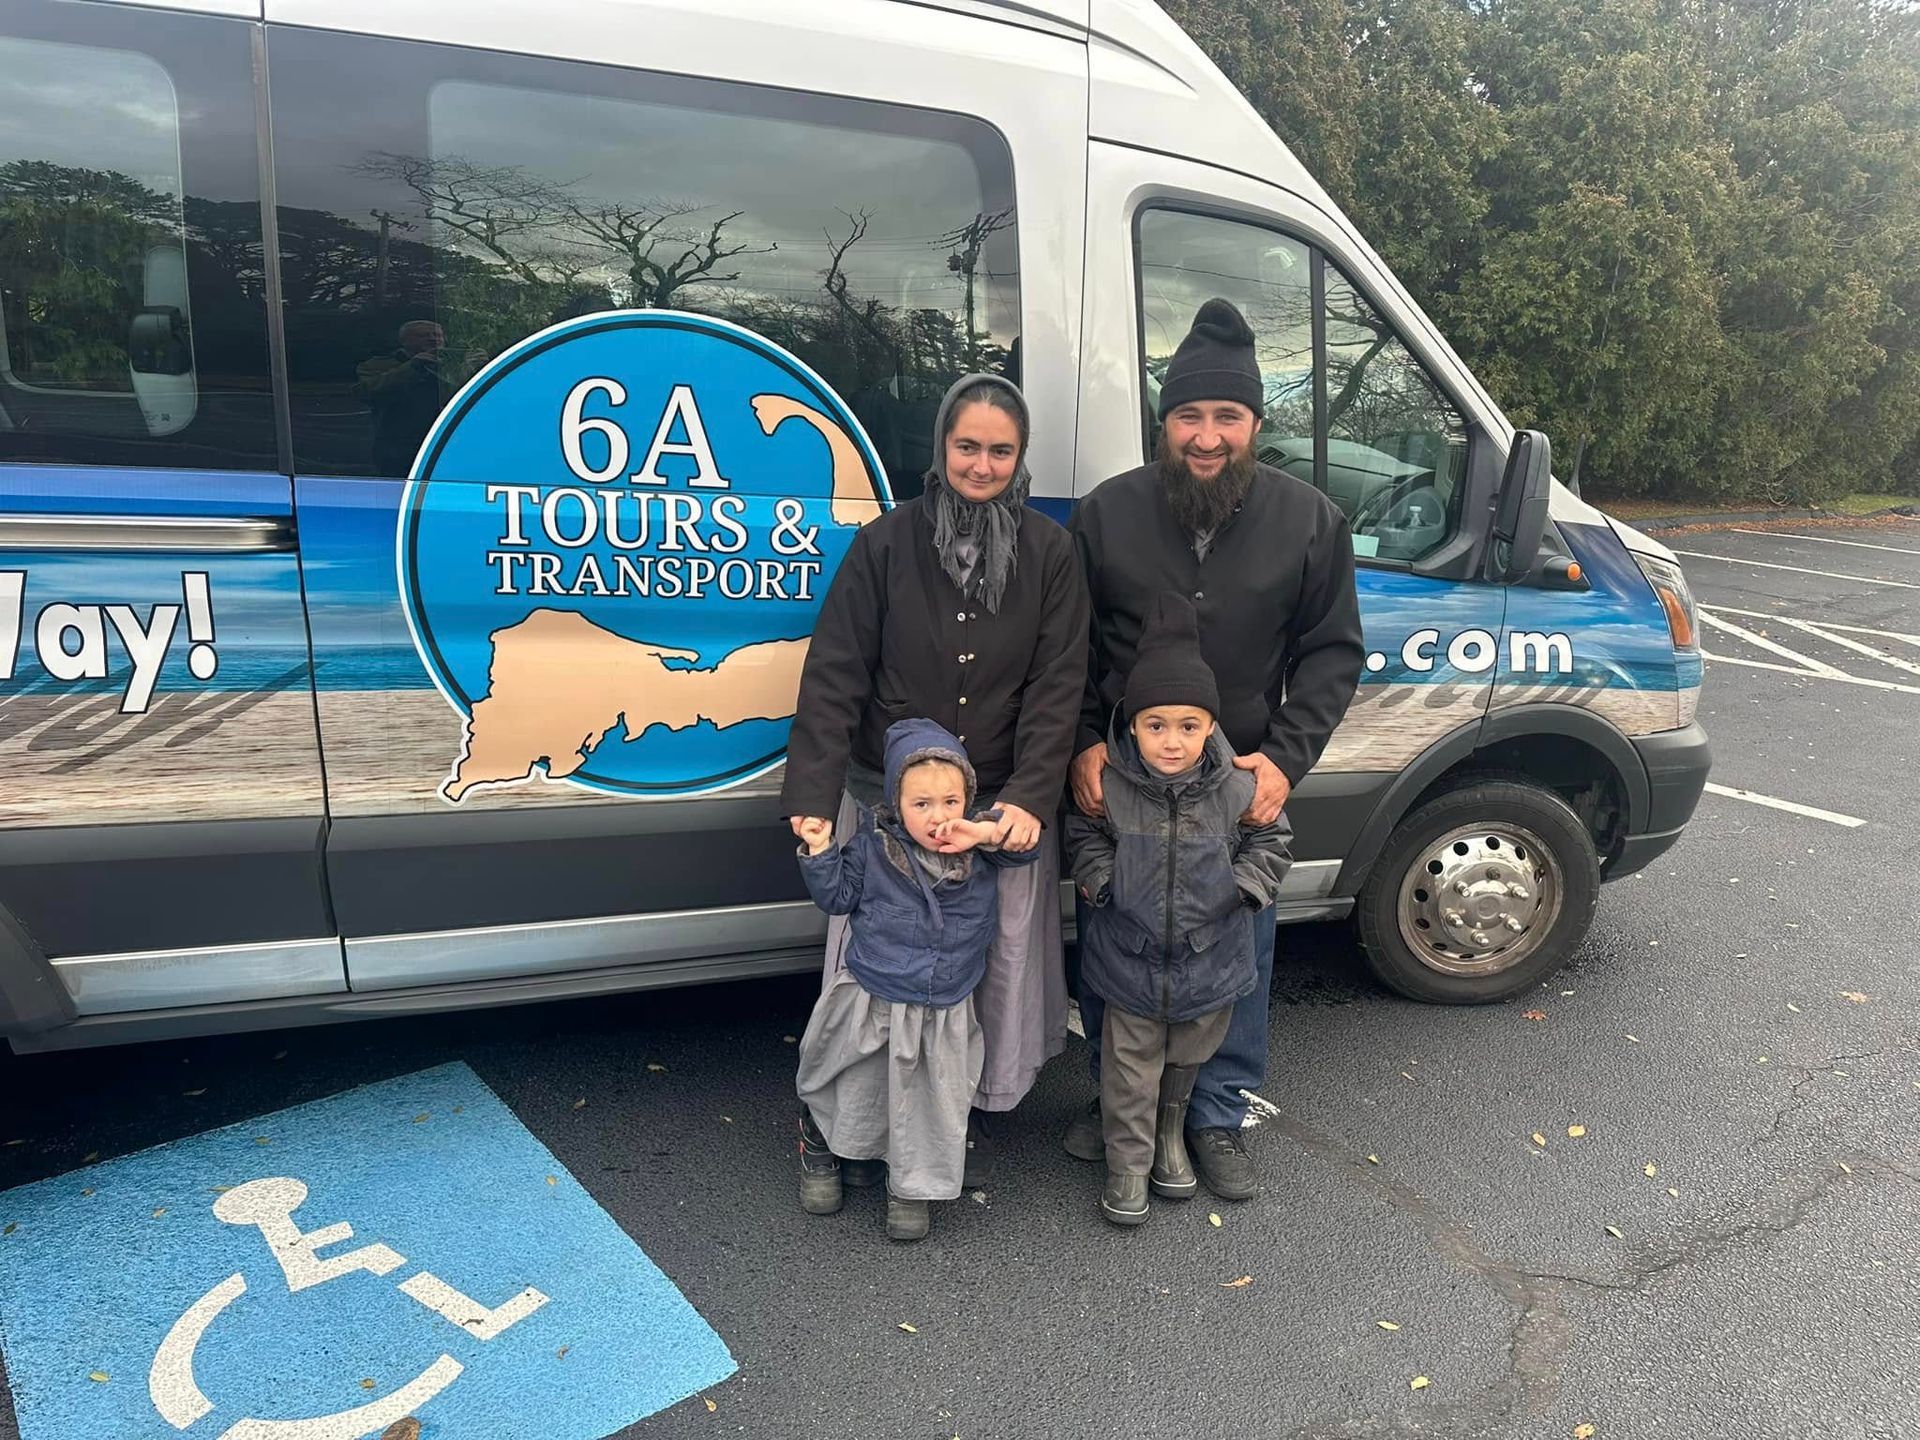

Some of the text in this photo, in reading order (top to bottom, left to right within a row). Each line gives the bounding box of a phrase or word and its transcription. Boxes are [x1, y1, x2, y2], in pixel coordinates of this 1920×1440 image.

[560, 376, 730, 489] 6A
[486, 485, 825, 557] TOURS &
[487, 551, 820, 601] TRANSPORT
